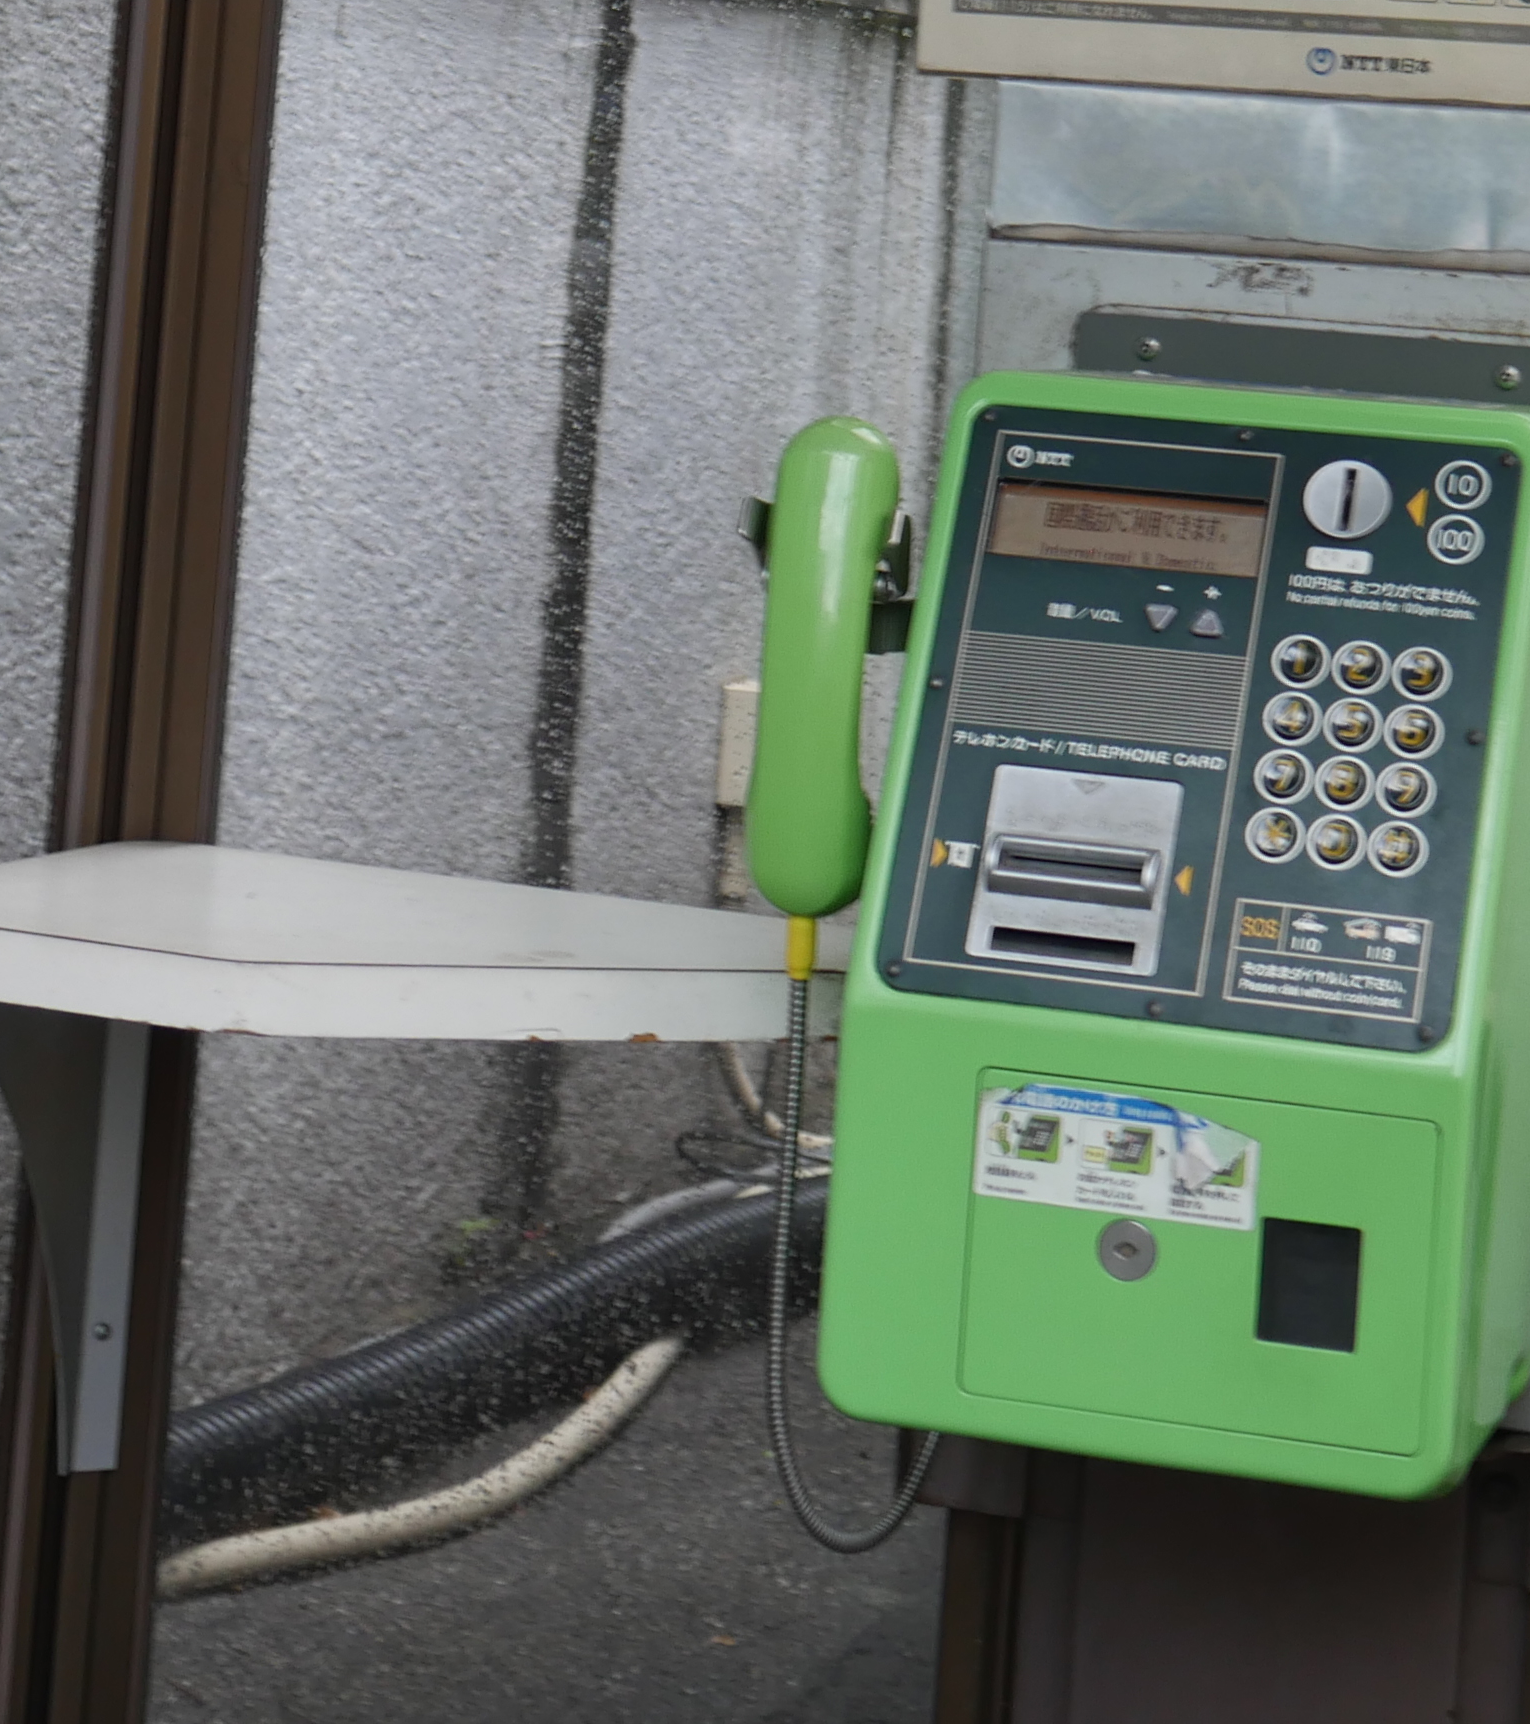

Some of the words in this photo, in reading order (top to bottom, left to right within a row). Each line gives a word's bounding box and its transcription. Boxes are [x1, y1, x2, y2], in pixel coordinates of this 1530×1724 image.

[1340, 53, 1432, 74] NTT東日本
[1034, 450, 1075, 468] NTT
[1445, 473, 1479, 498] 10
[1435, 528, 1475, 553] 100
[1347, 647, 1374, 682] 2
[1406, 653, 1434, 687] 3
[1274, 700, 1306, 733] 4
[1336, 704, 1365, 739] 5
[1396, 712, 1427, 747] 6
[1173, 753, 1228, 771] CARD
[1265, 757, 1297, 792] 7
[1326, 764, 1358, 799] 8
[1389, 770, 1420, 804] 9
[1239, 915, 1280, 940] SOS
[1290, 935, 1323, 954] 110
[1366, 945, 1397, 963] 119
